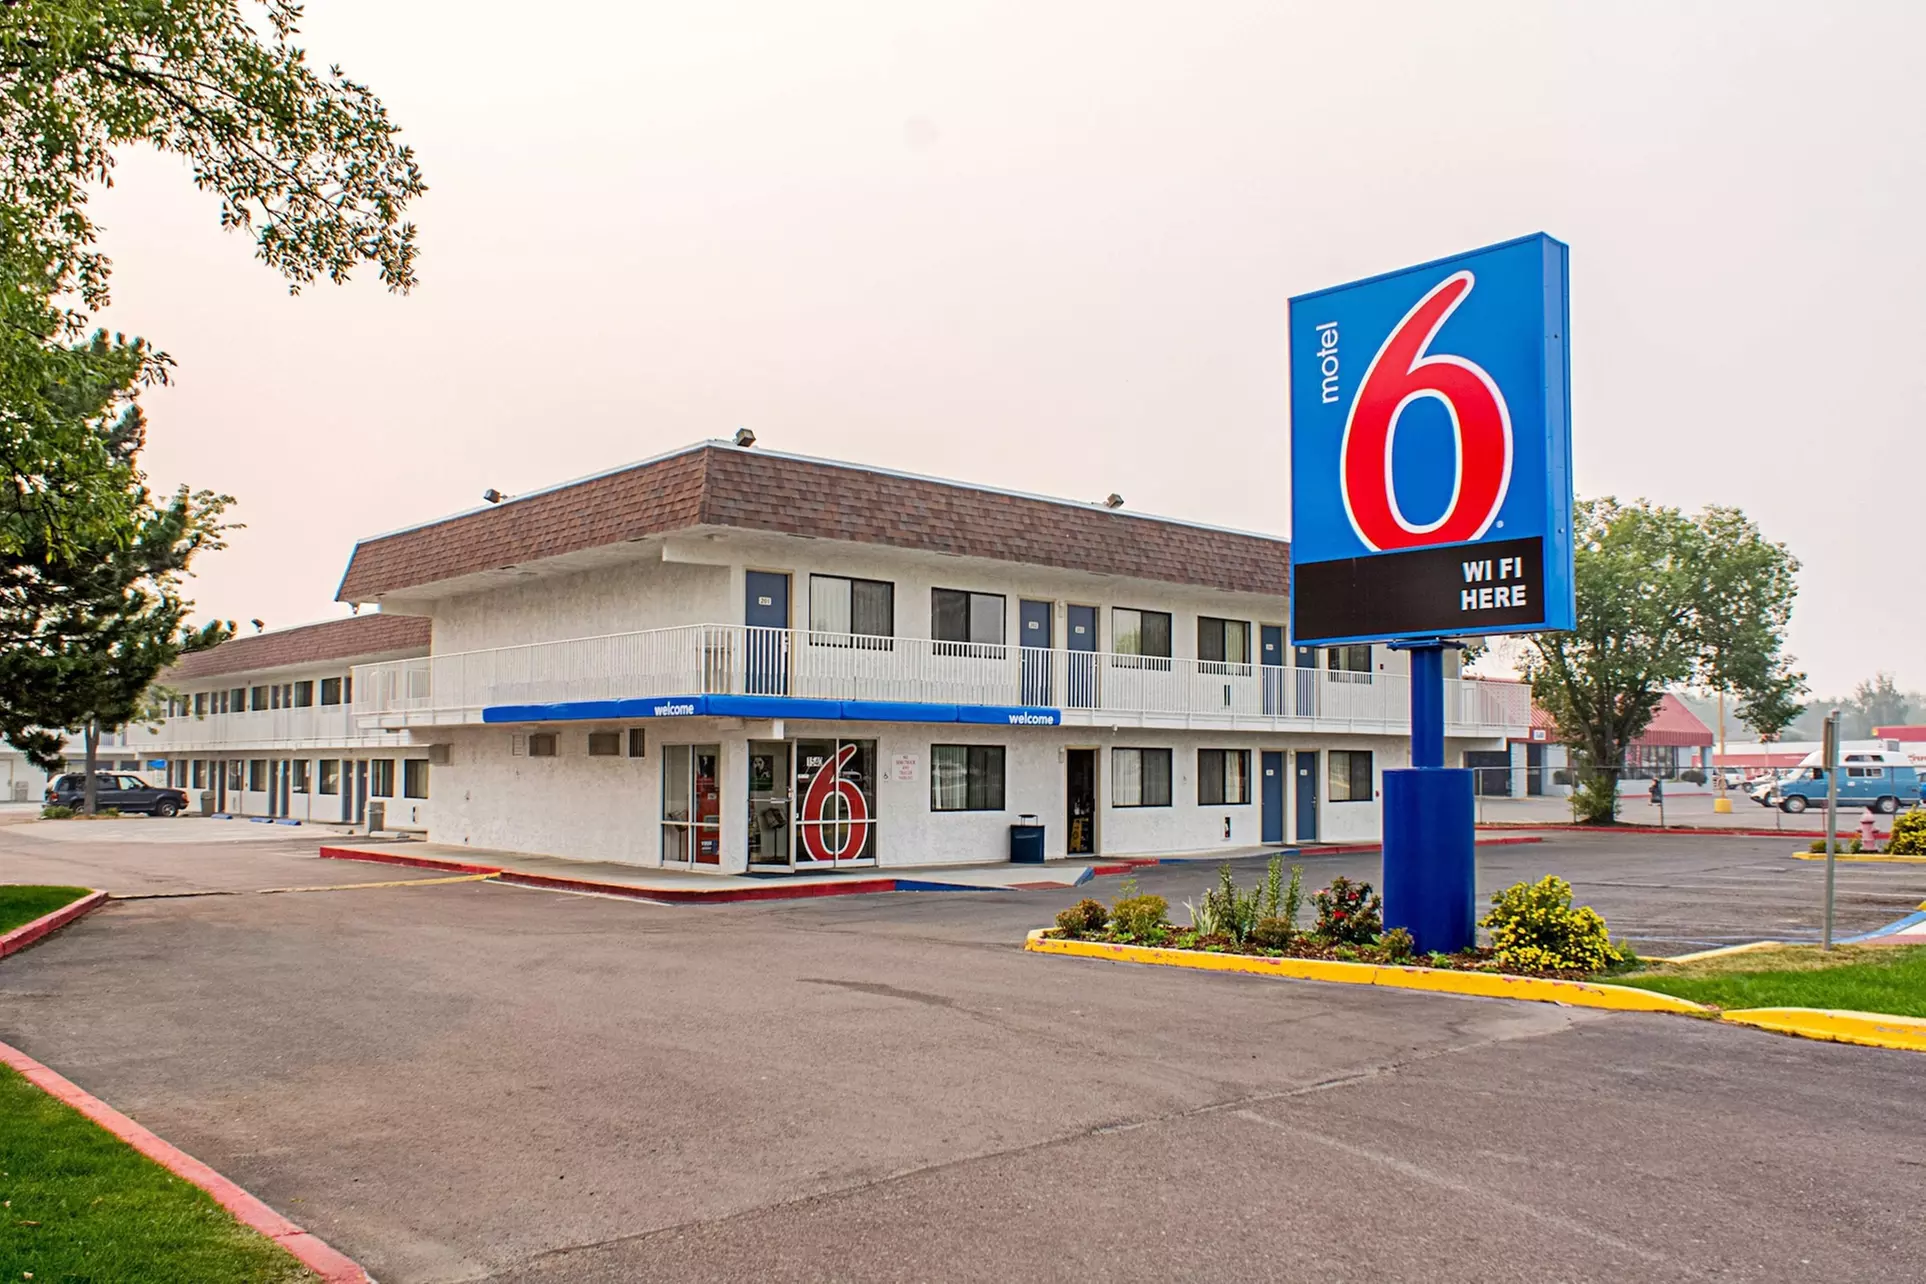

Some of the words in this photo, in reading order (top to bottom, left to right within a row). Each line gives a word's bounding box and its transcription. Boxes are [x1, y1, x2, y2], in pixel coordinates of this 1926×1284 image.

[1316, 321, 1340, 404] motel
[1340, 270, 1514, 552] 6
[1462, 560, 1492, 583] WI
[1500, 557, 1522, 580] FI
[1461, 585, 1527, 611] HERE
[654, 701, 694, 716] welcome
[1008, 711, 1054, 725] welcome
[801, 743, 868, 861] 6
